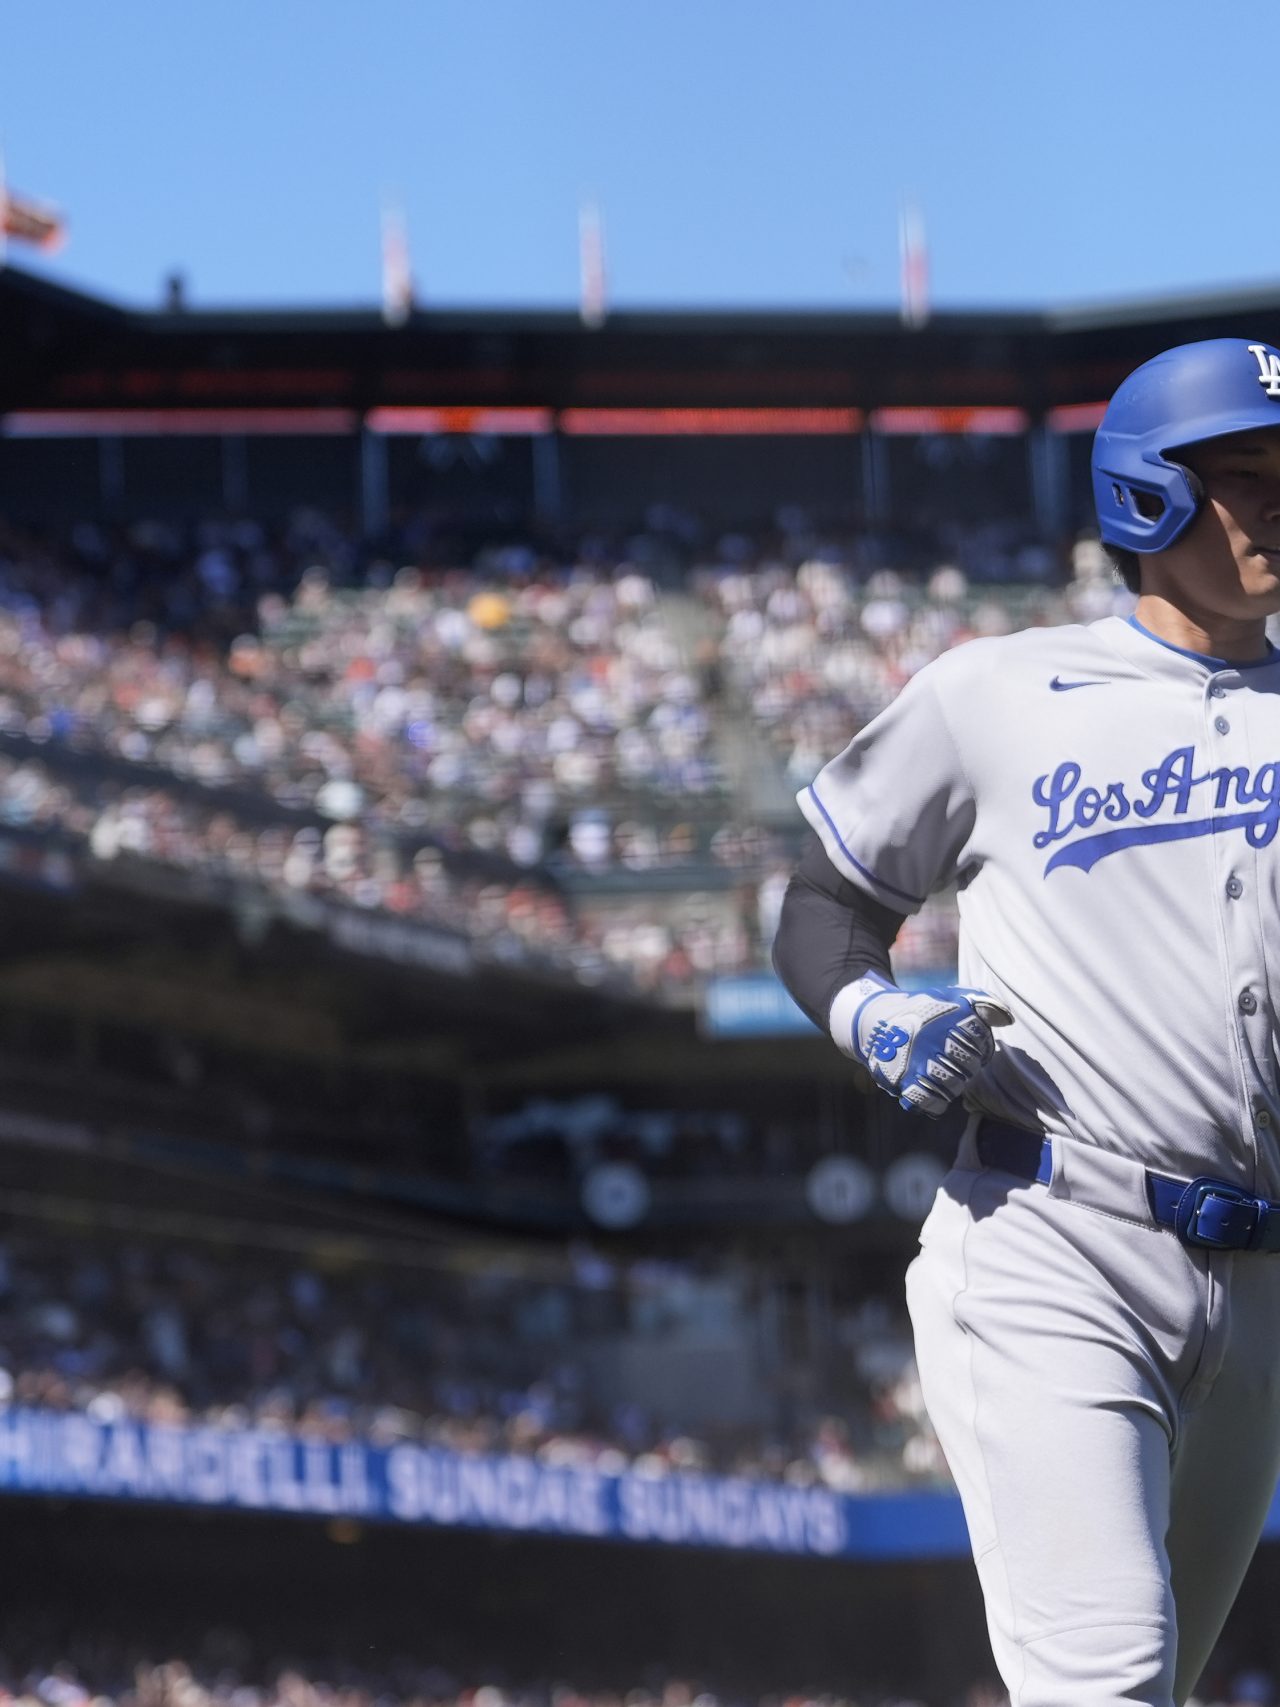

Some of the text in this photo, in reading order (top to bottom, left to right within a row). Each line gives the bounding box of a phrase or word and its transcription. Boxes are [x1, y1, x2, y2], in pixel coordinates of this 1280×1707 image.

[1032, 761, 1131, 849] Los
[386, 1441, 609, 1538] SUNDAE
[617, 1474, 849, 1557] SUNDAYS
